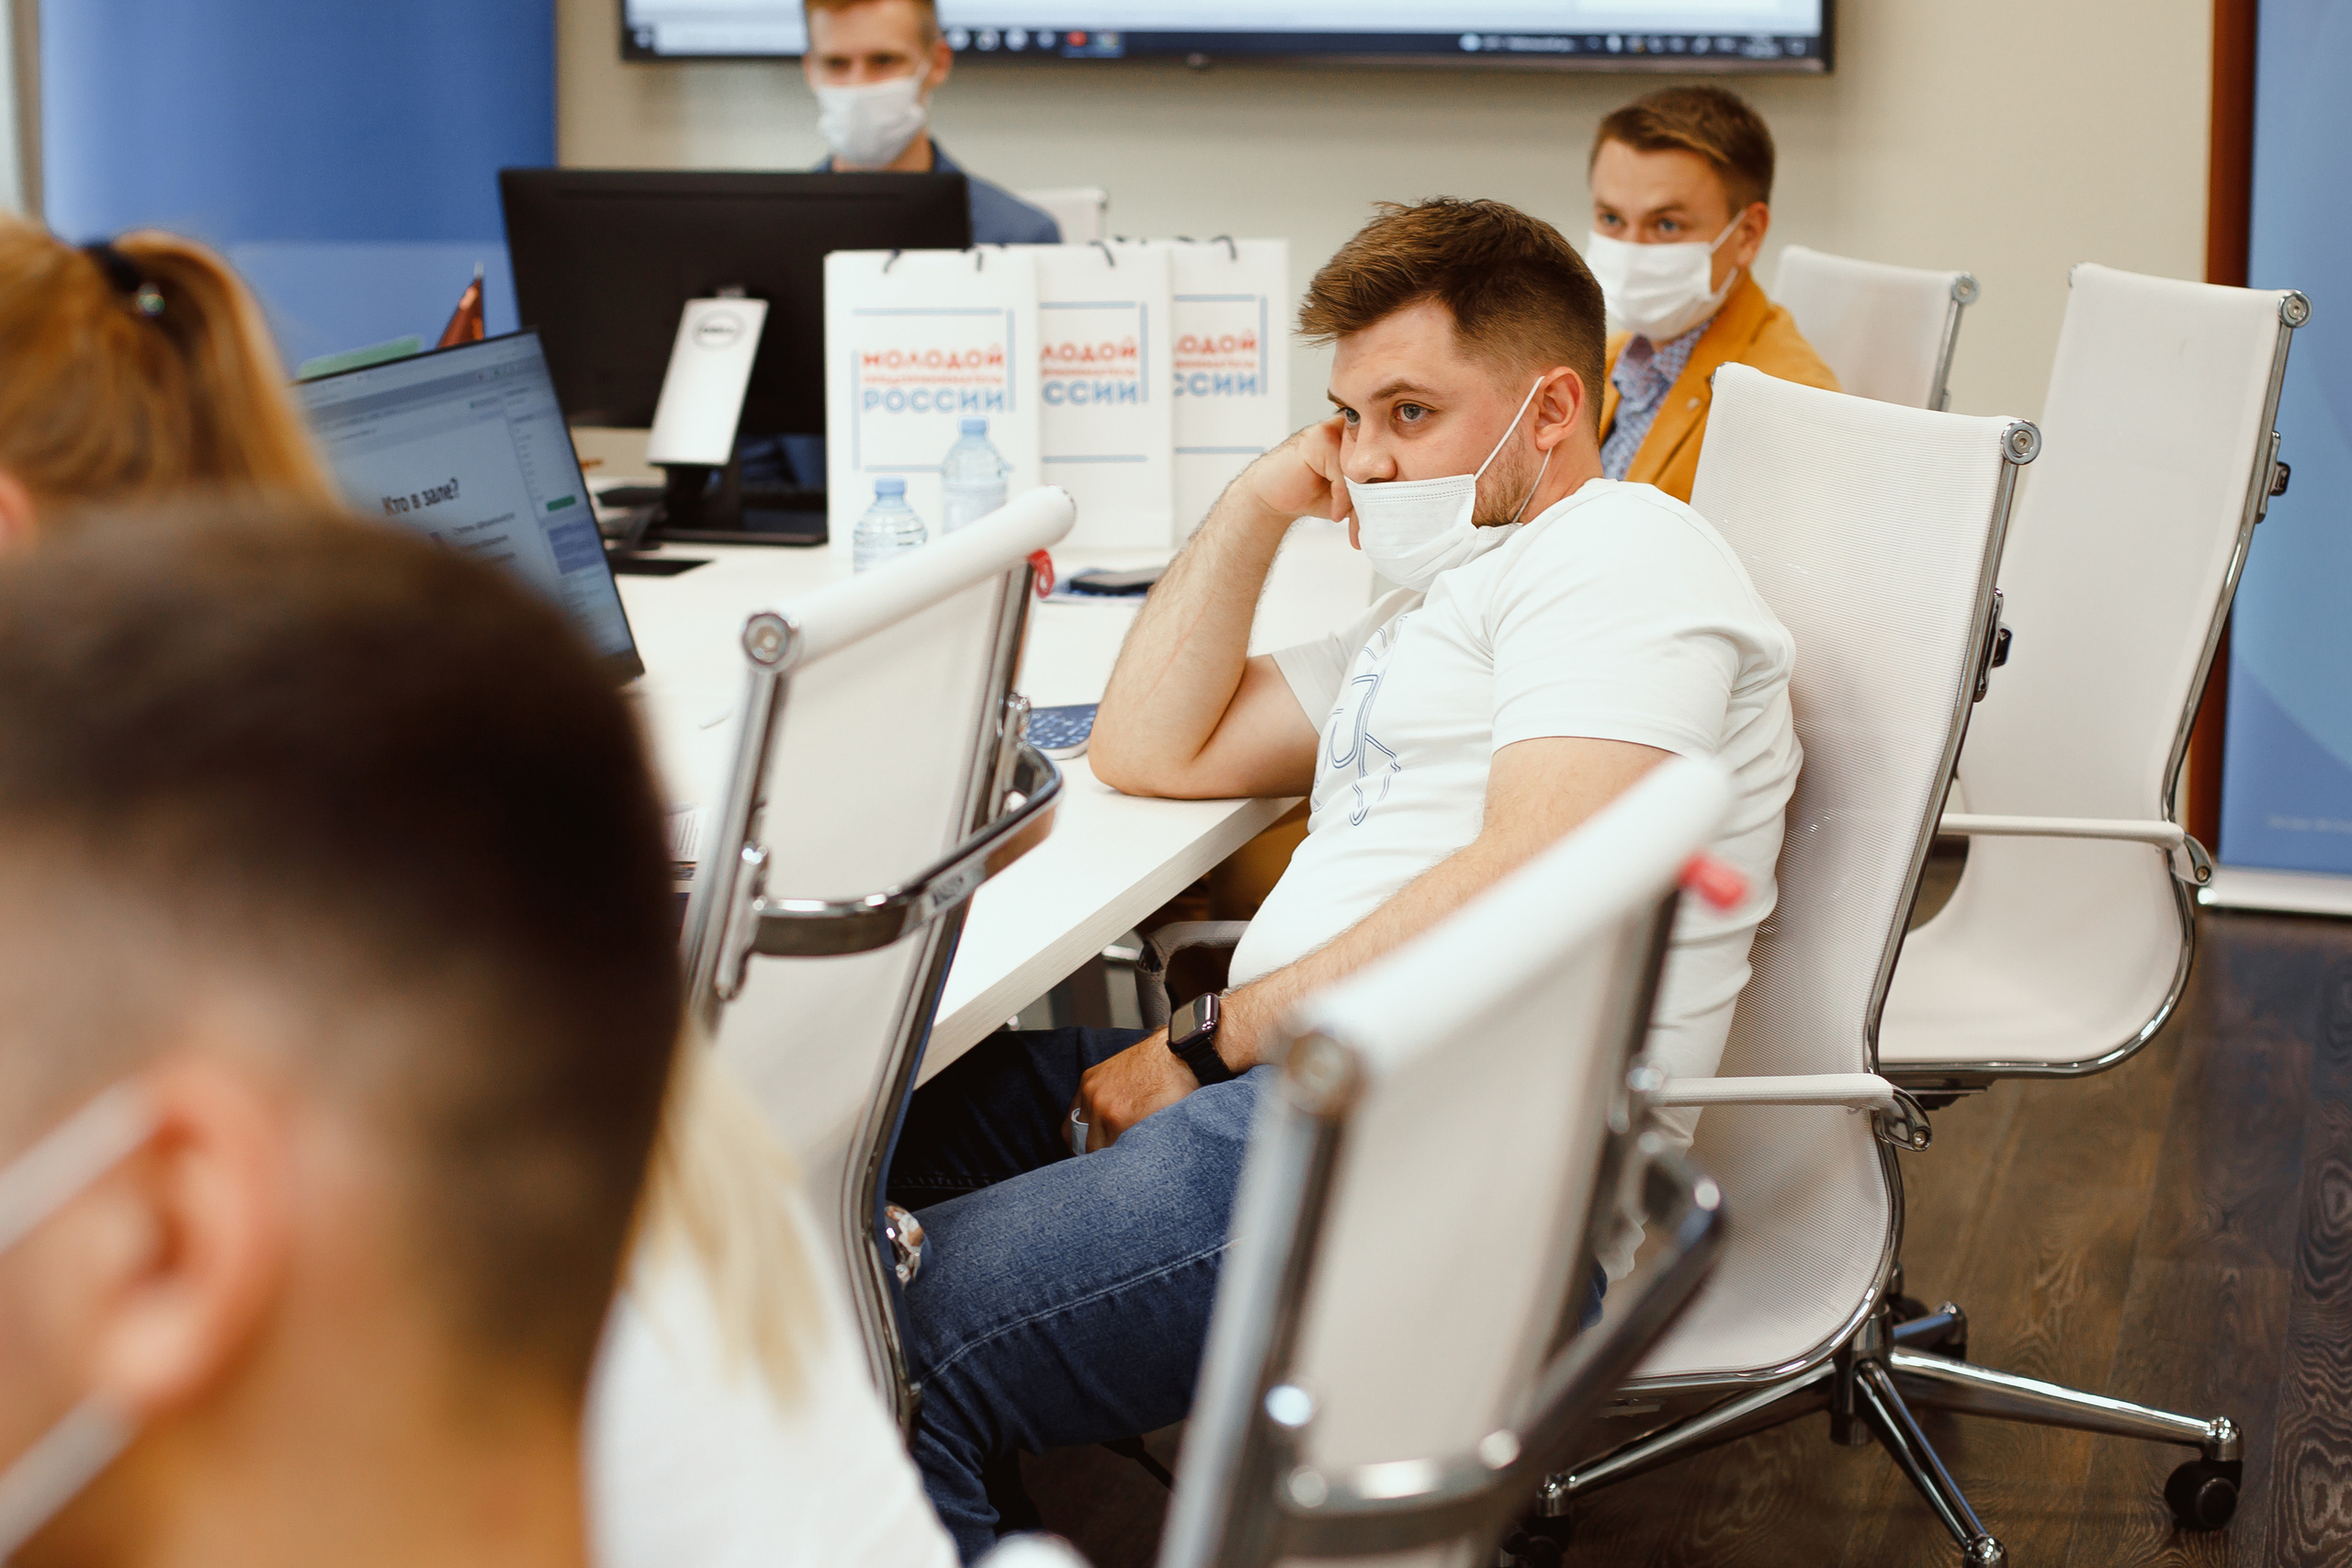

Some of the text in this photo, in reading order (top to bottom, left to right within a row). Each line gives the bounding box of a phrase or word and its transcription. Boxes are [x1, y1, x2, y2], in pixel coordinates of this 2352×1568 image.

[1173, 330, 1256, 354] ОДОЙ
[863, 344, 1003, 369] МОЛОДОЙ
[863, 388, 1005, 413] РОССИИ
[382, 495, 410, 516] Кто
[422, 477, 459, 506] зале?
